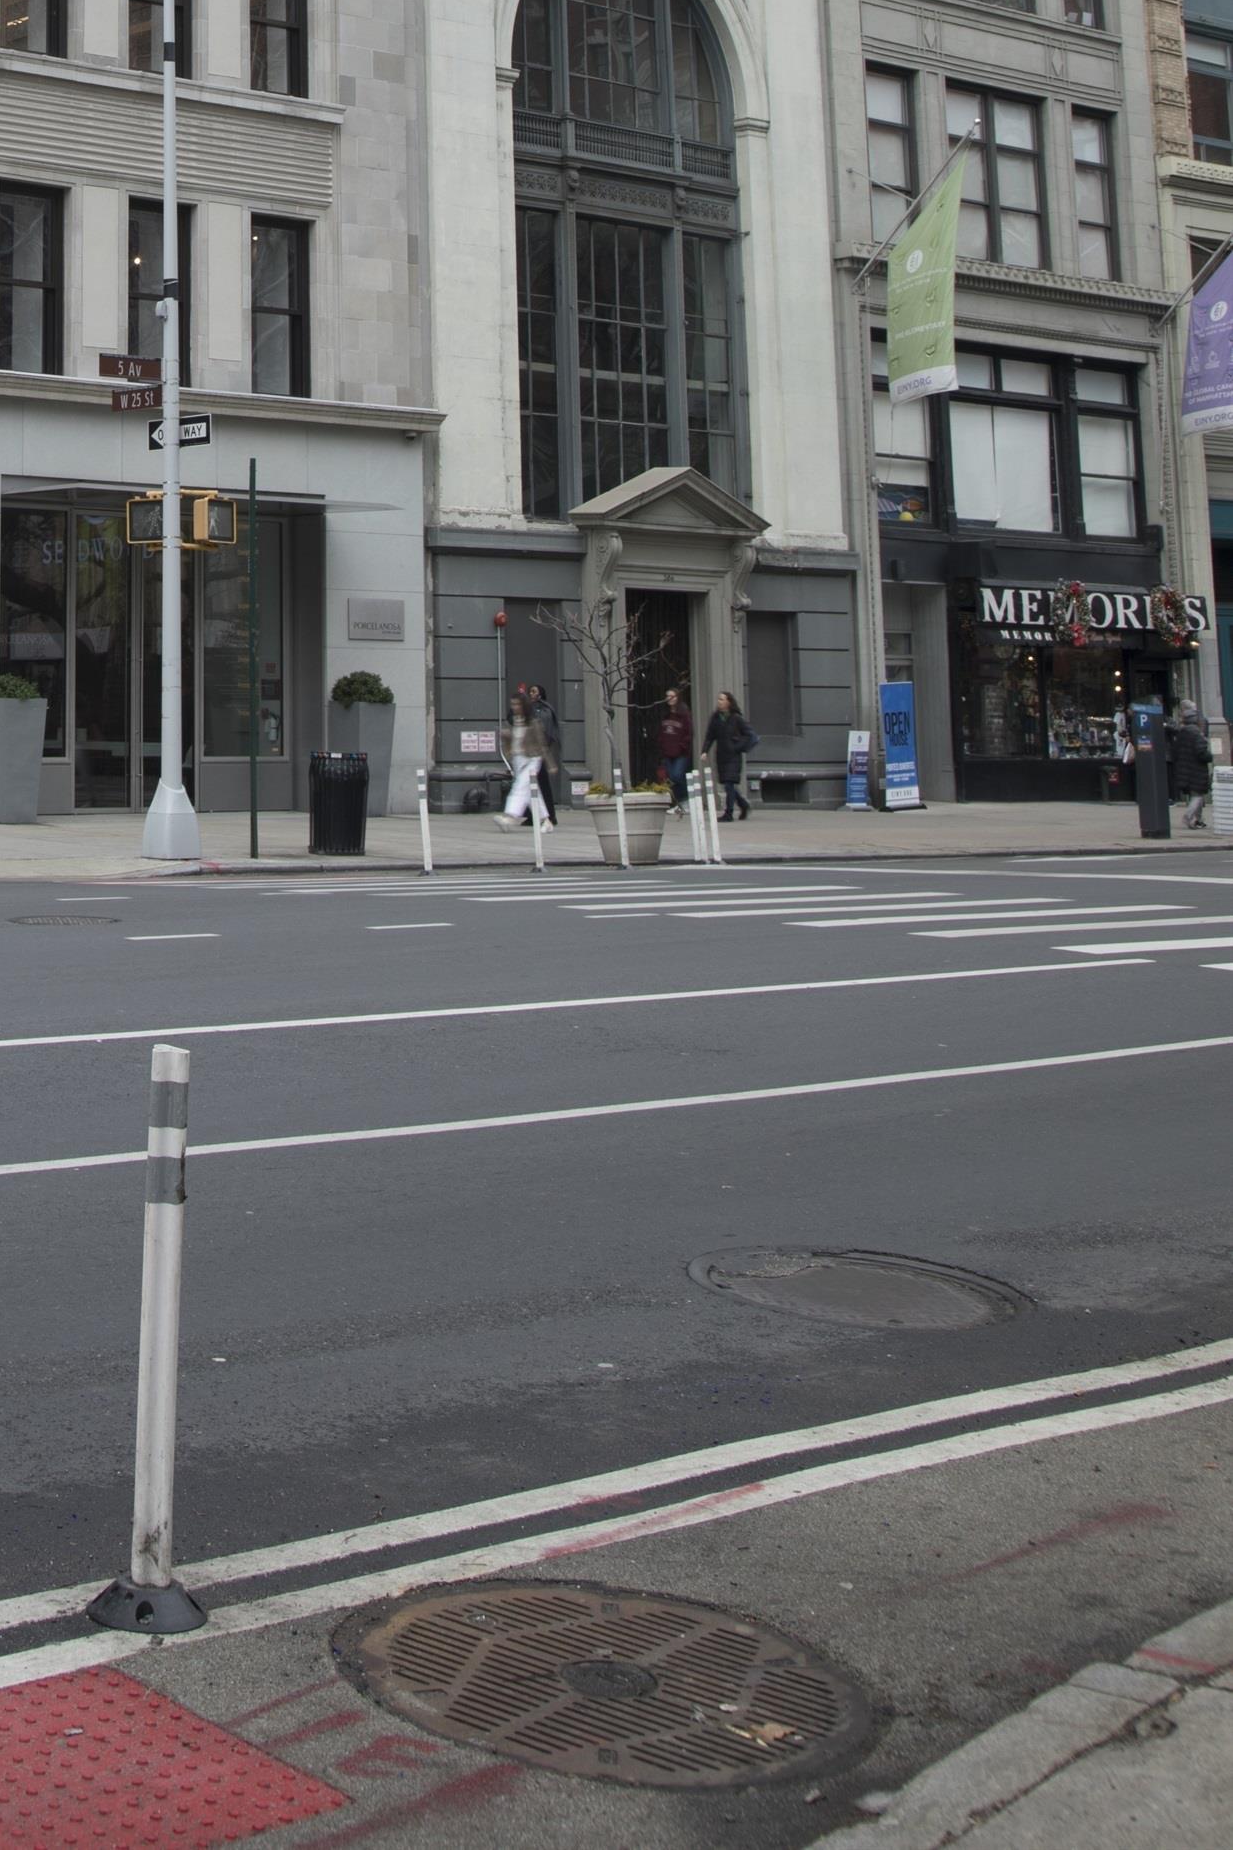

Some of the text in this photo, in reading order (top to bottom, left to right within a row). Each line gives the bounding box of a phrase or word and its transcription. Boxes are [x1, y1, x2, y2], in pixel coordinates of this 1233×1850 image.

[118, 360, 142, 377] 5 Av
[120, 390, 154, 409] W 25 St
[183, 424, 203, 438] WAY
[980, 587, 1206, 631] MEMORIS
[353, 621, 402, 631] PORCELANOSA
[884, 711, 911, 735] OPEN
[1140, 714, 1148, 726] P
[889, 734, 909, 747] HOUSE
